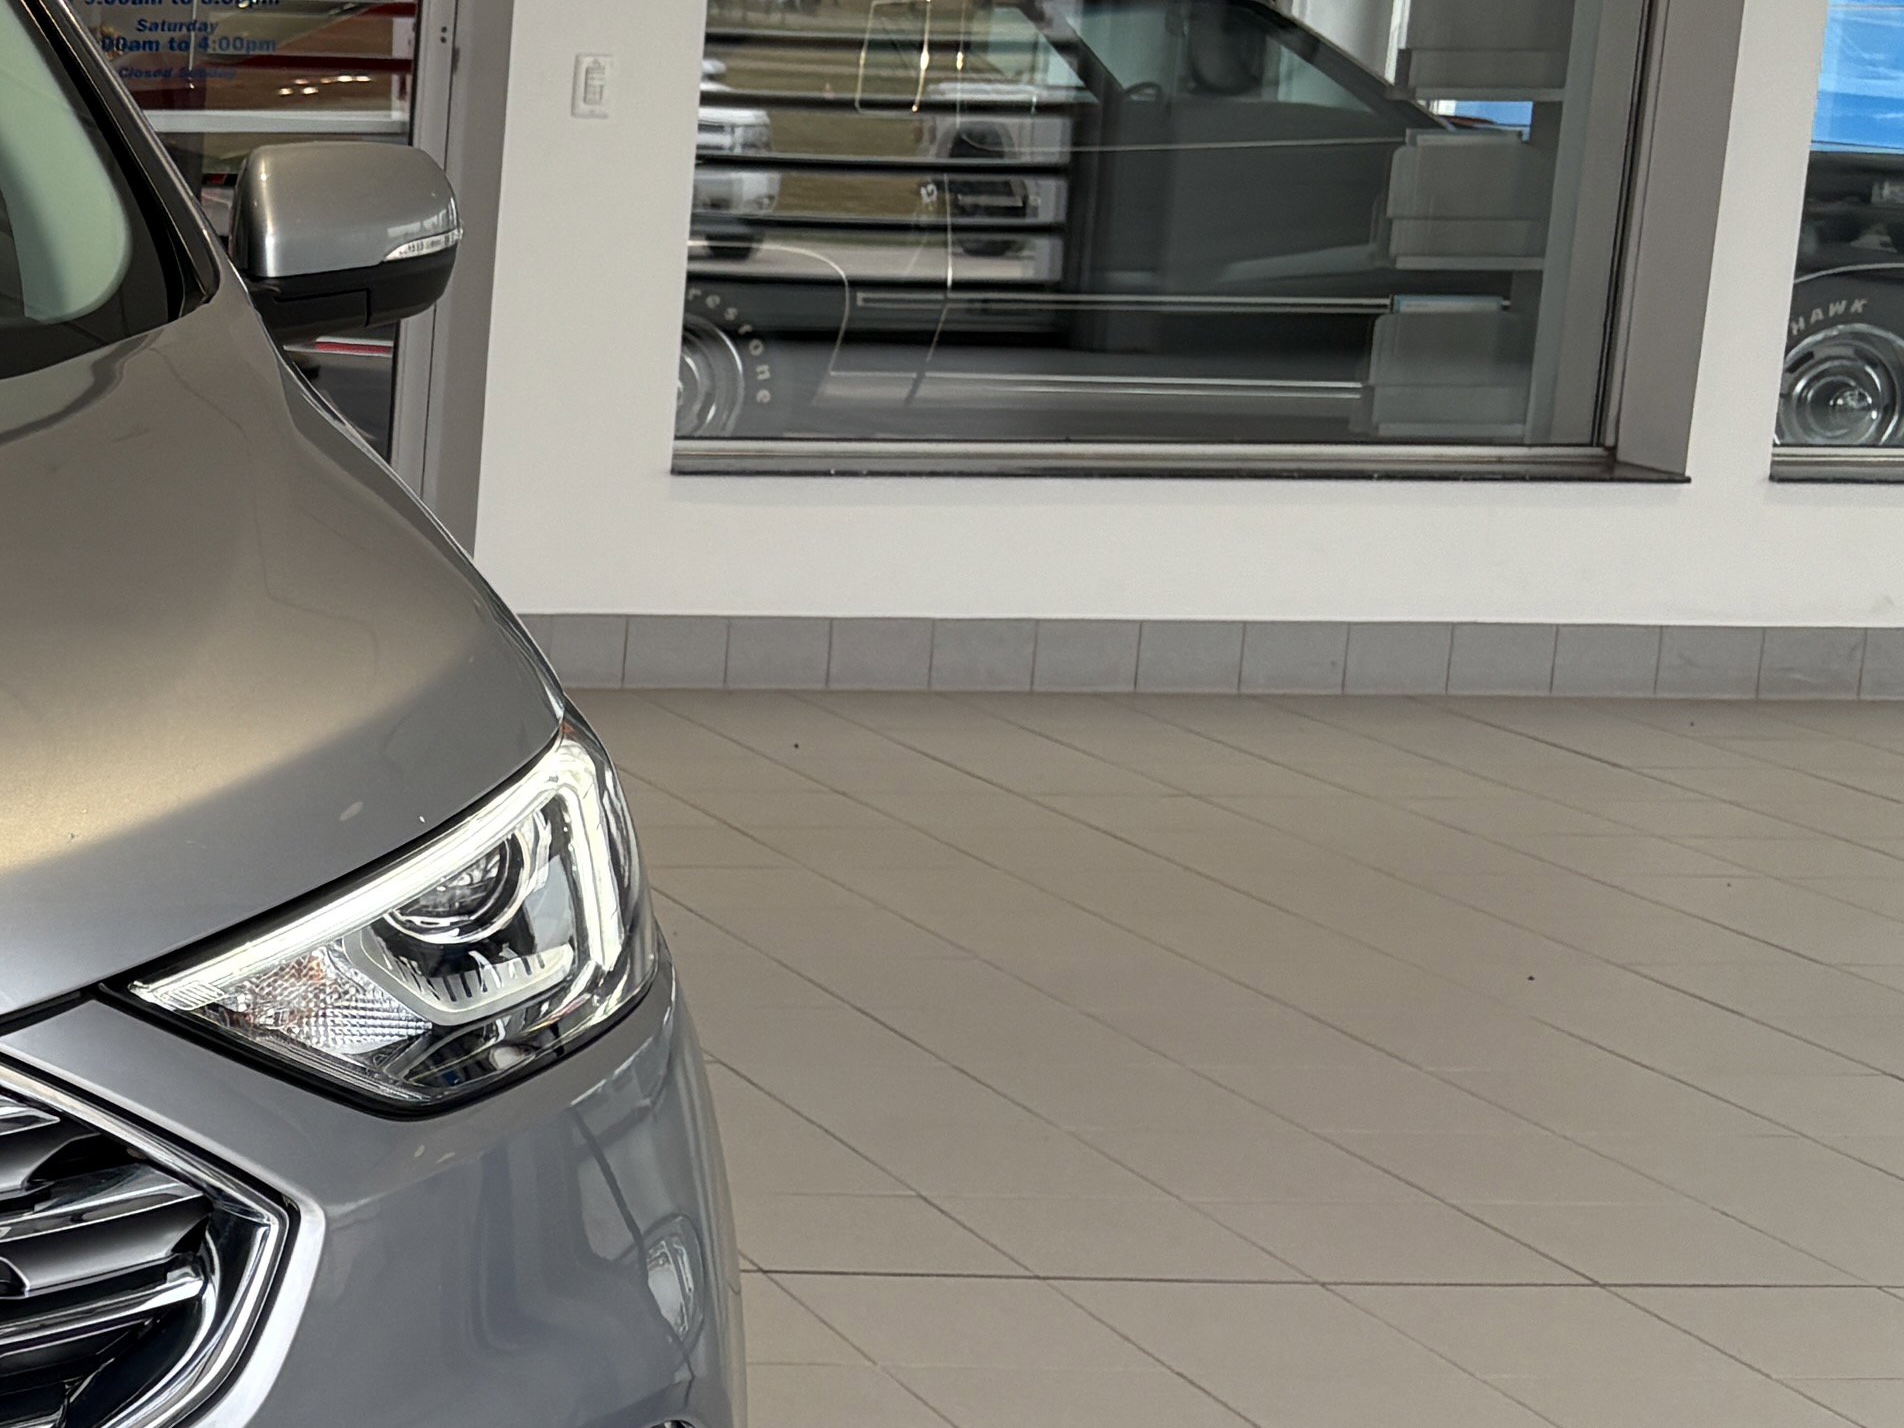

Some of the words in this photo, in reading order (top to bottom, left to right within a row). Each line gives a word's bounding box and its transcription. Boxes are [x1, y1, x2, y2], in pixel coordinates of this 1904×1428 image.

[136, 18, 219, 35] Saturday
[97, 36, 161, 53] 00am
[168, 36, 190, 52] to
[198, 36, 278, 54] 4:00pm
[1790, 298, 1867, 336] HAWK
[687, 287, 771, 404] restone
